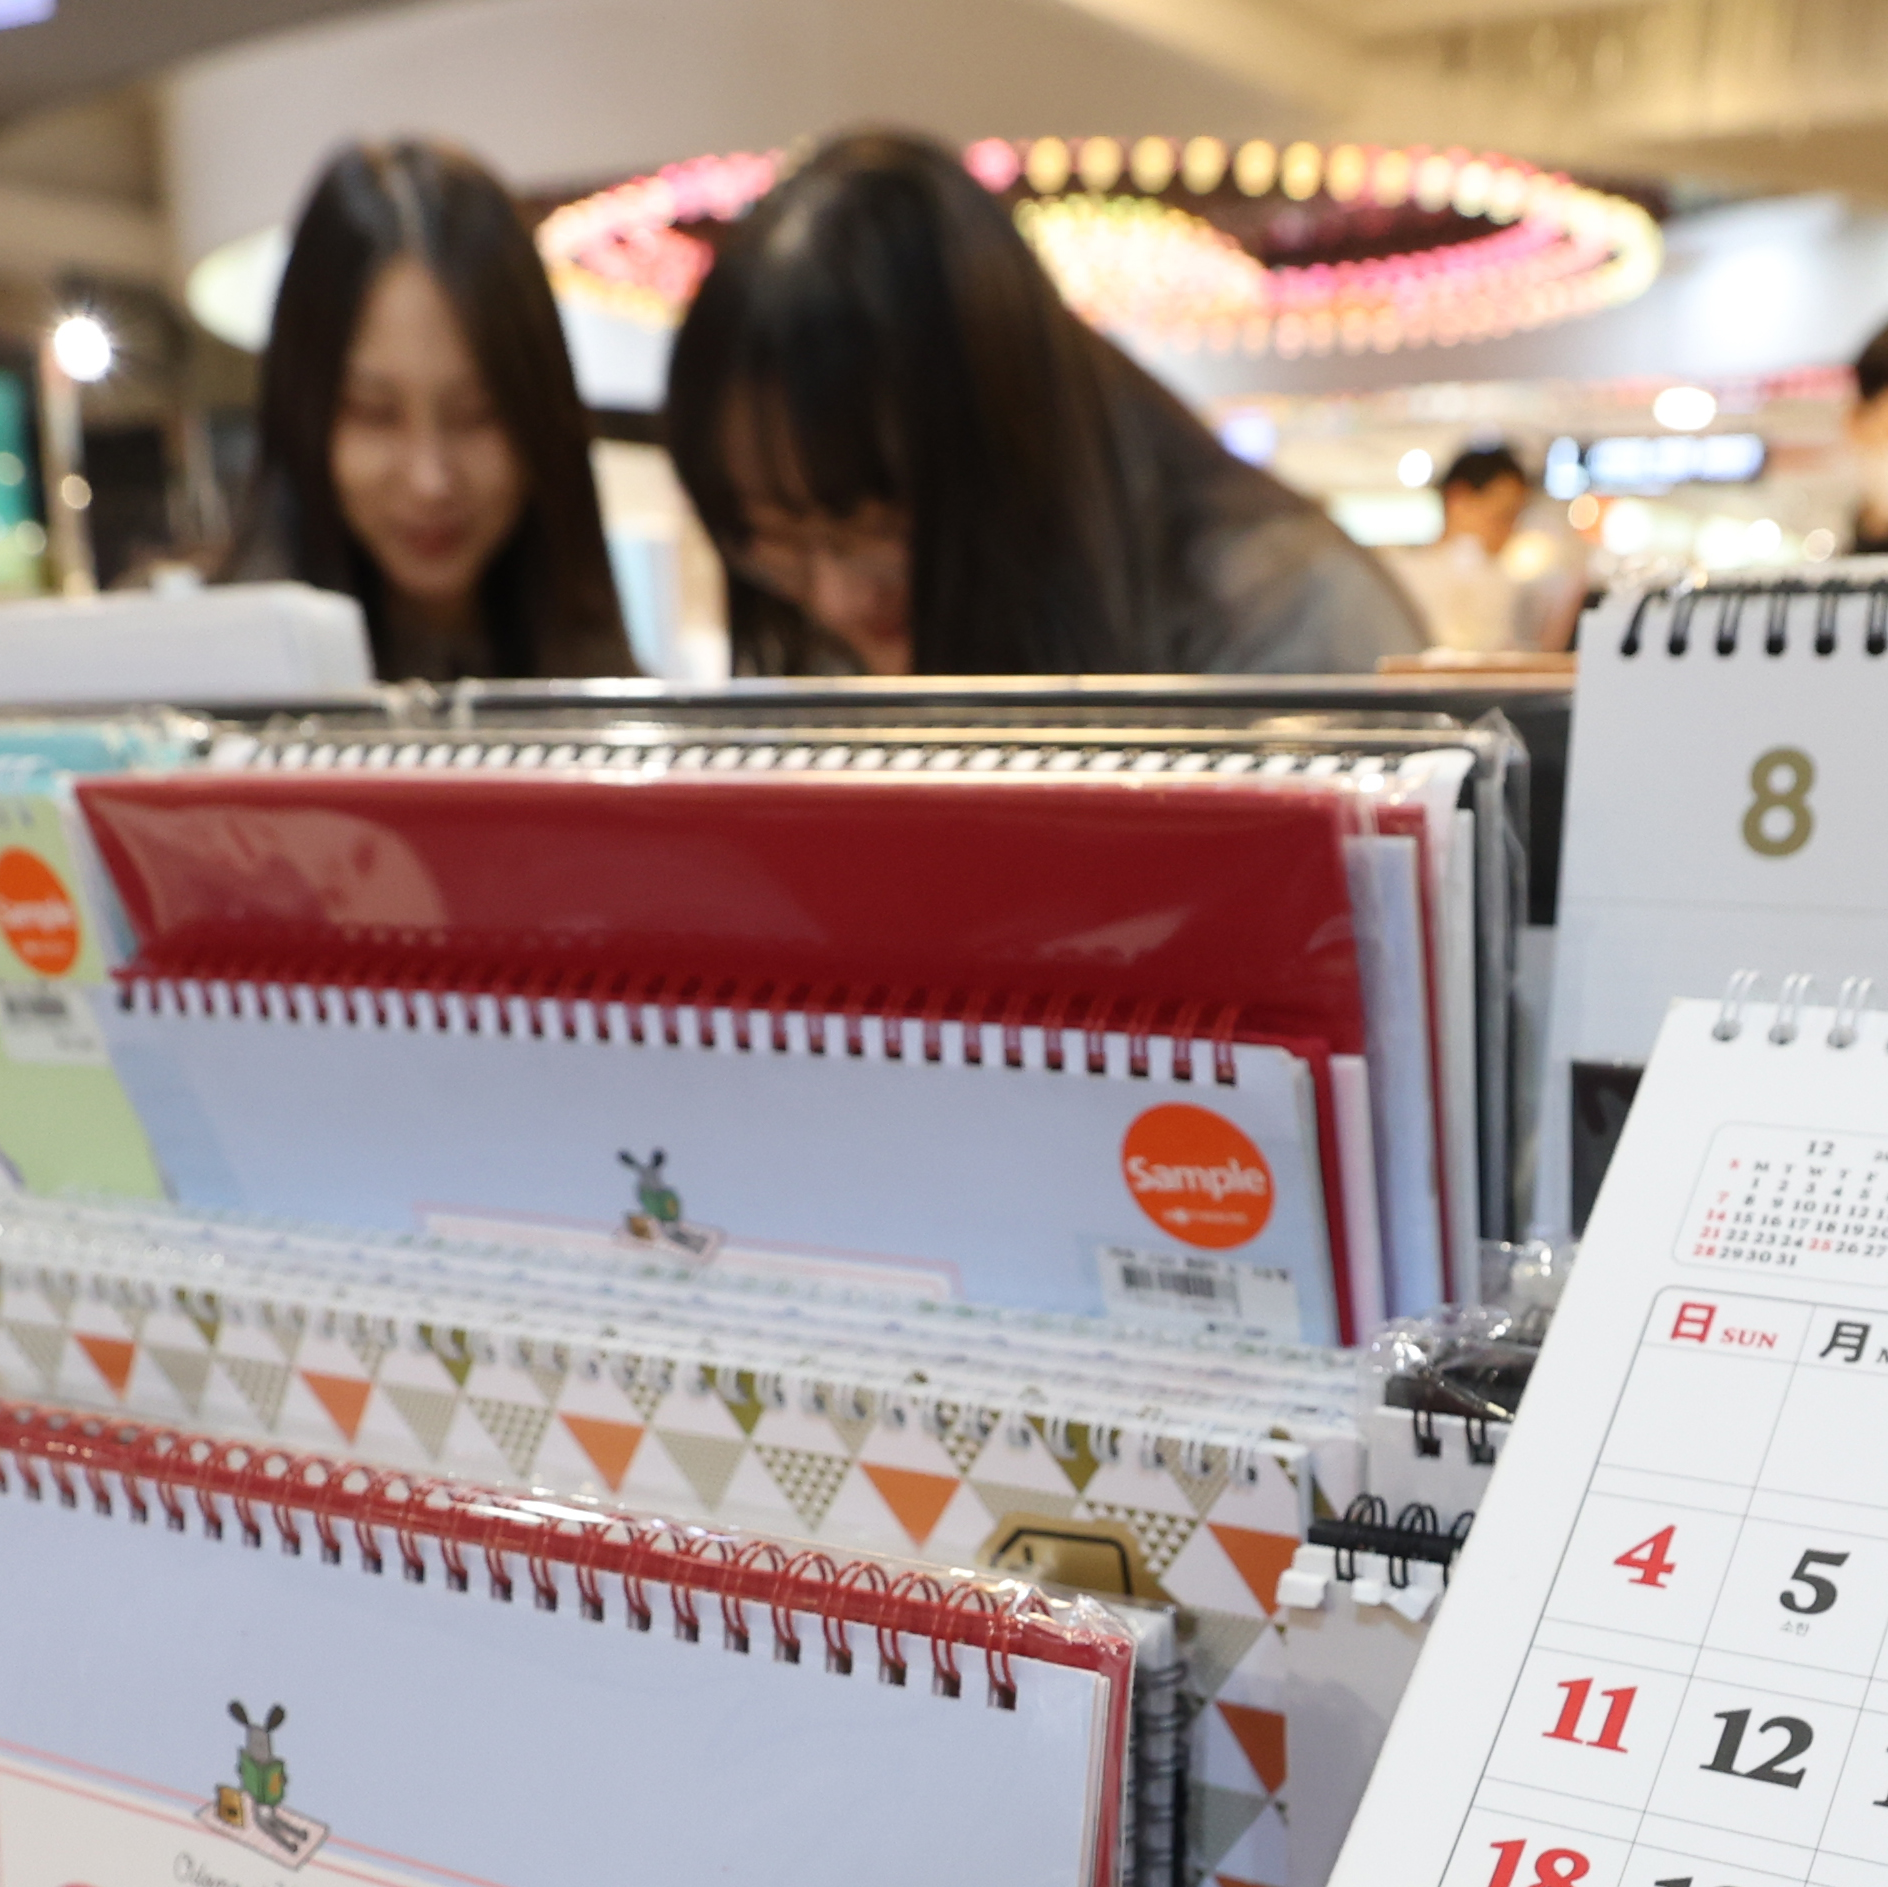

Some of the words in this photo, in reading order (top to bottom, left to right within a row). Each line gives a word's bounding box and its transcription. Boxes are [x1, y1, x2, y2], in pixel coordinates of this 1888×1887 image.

[1739, 744, 1818, 860] 8
[1126, 1156, 1267, 1203] Sample
[1807, 1140, 1835, 1157] 12
[1670, 1301, 1717, 1344] 日
[1720, 1327, 1779, 1351] SUN
[1819, 1320, 1871, 1364] 月
[1613, 1524, 1676, 1589] 4
[1779, 1548, 1850, 1616] 5
[1542, 1677, 1637, 1753] 11
[1699, 1708, 1814, 1790] 12
